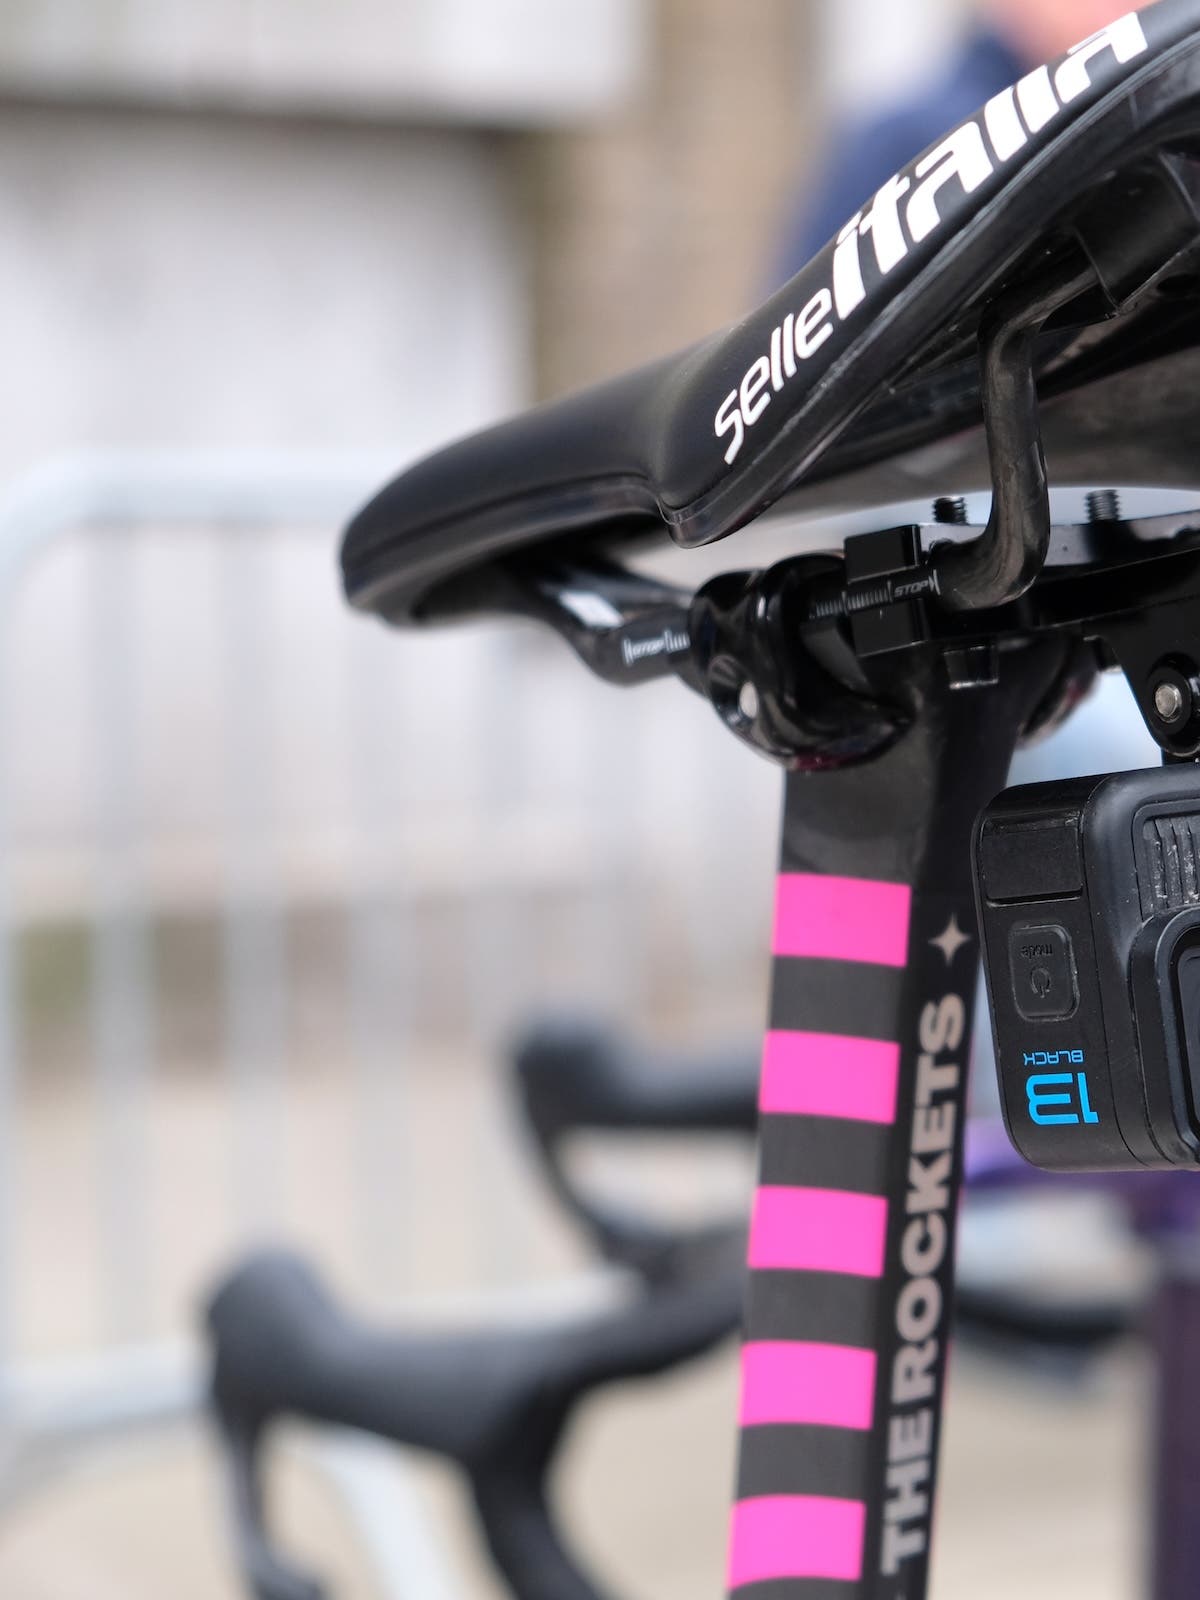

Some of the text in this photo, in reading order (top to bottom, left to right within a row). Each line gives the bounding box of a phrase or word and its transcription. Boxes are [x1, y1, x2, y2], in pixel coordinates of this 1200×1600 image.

[714, 288, 833, 464] selle
[894, 579, 929, 598] STOP
[1023, 1050, 1084, 1065] BLACK
[1025, 1072, 1099, 1125] 13
[880, 993, 965, 1576] THE ROCKETS
